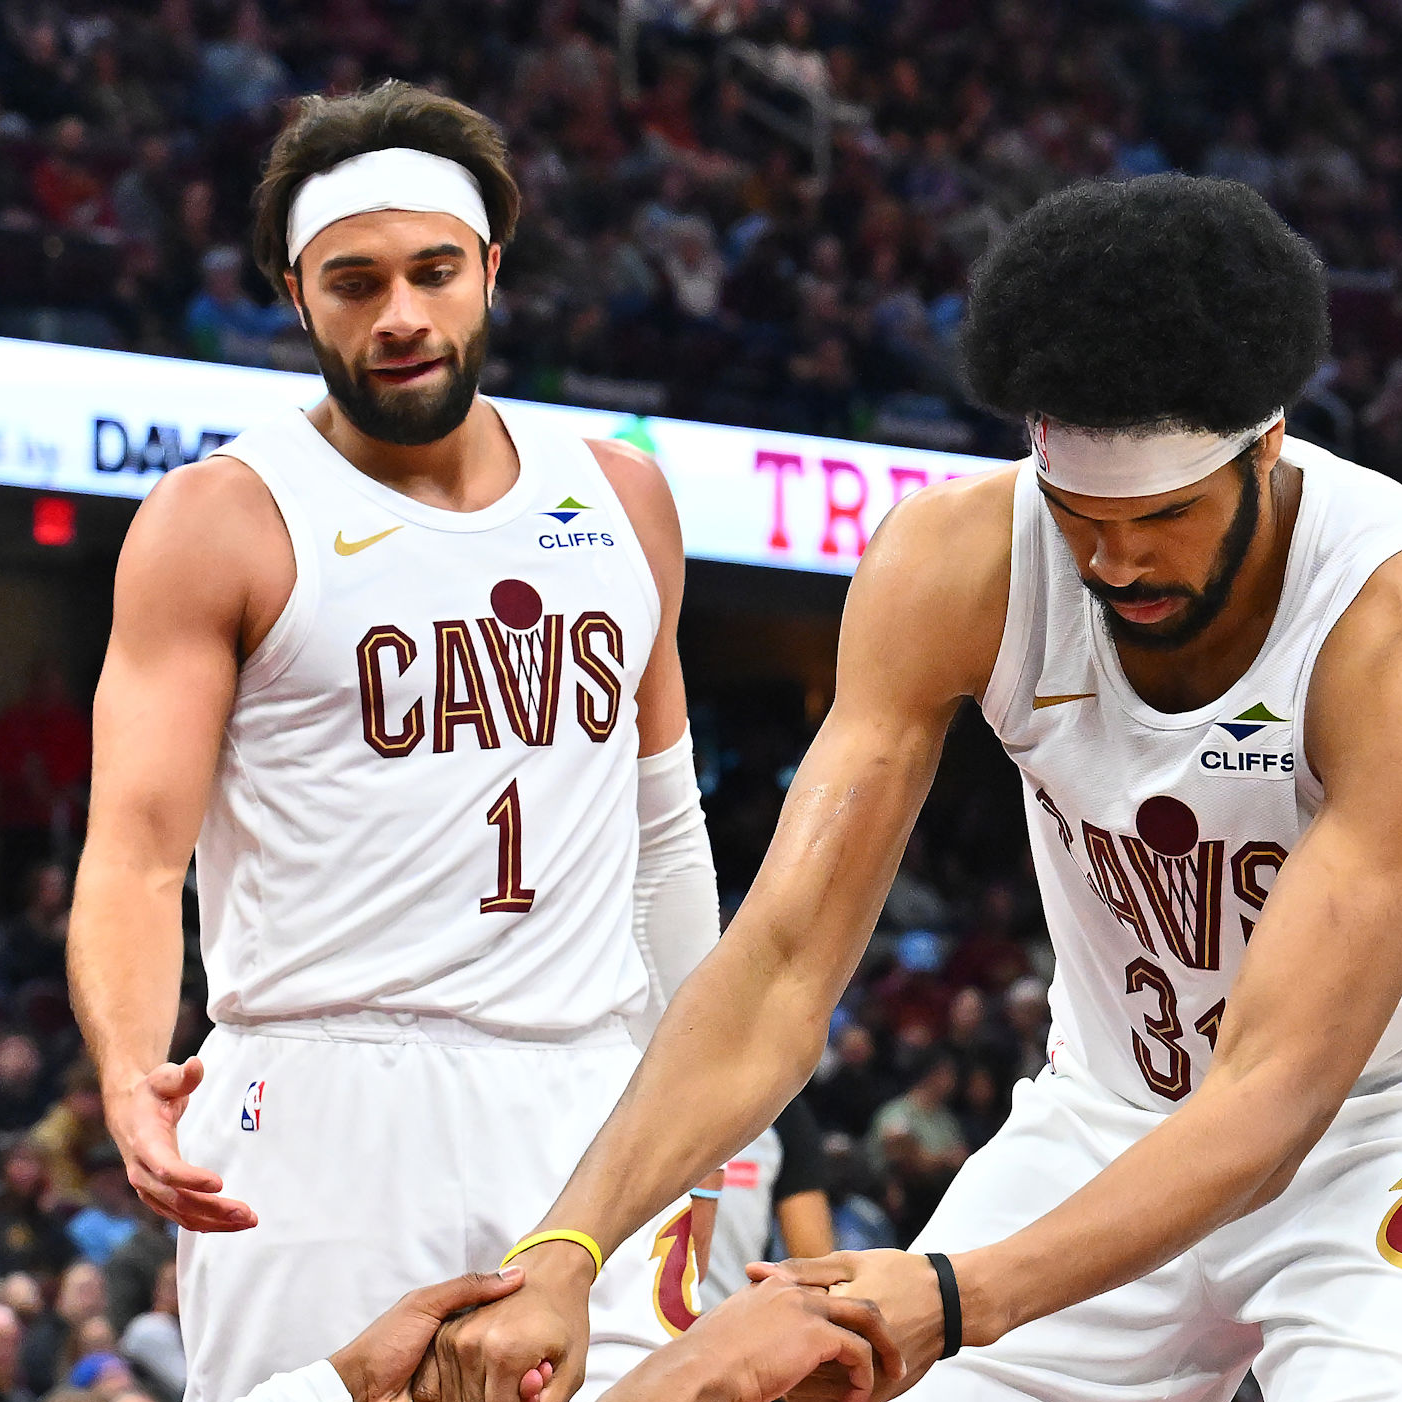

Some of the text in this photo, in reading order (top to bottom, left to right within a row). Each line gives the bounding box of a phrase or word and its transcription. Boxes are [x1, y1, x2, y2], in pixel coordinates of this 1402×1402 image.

[538, 531, 615, 550] CLIFFS
[356, 610, 625, 759] CAVS
[1200, 749, 1295, 773] CLIFFS
[480, 777, 536, 915] 1
